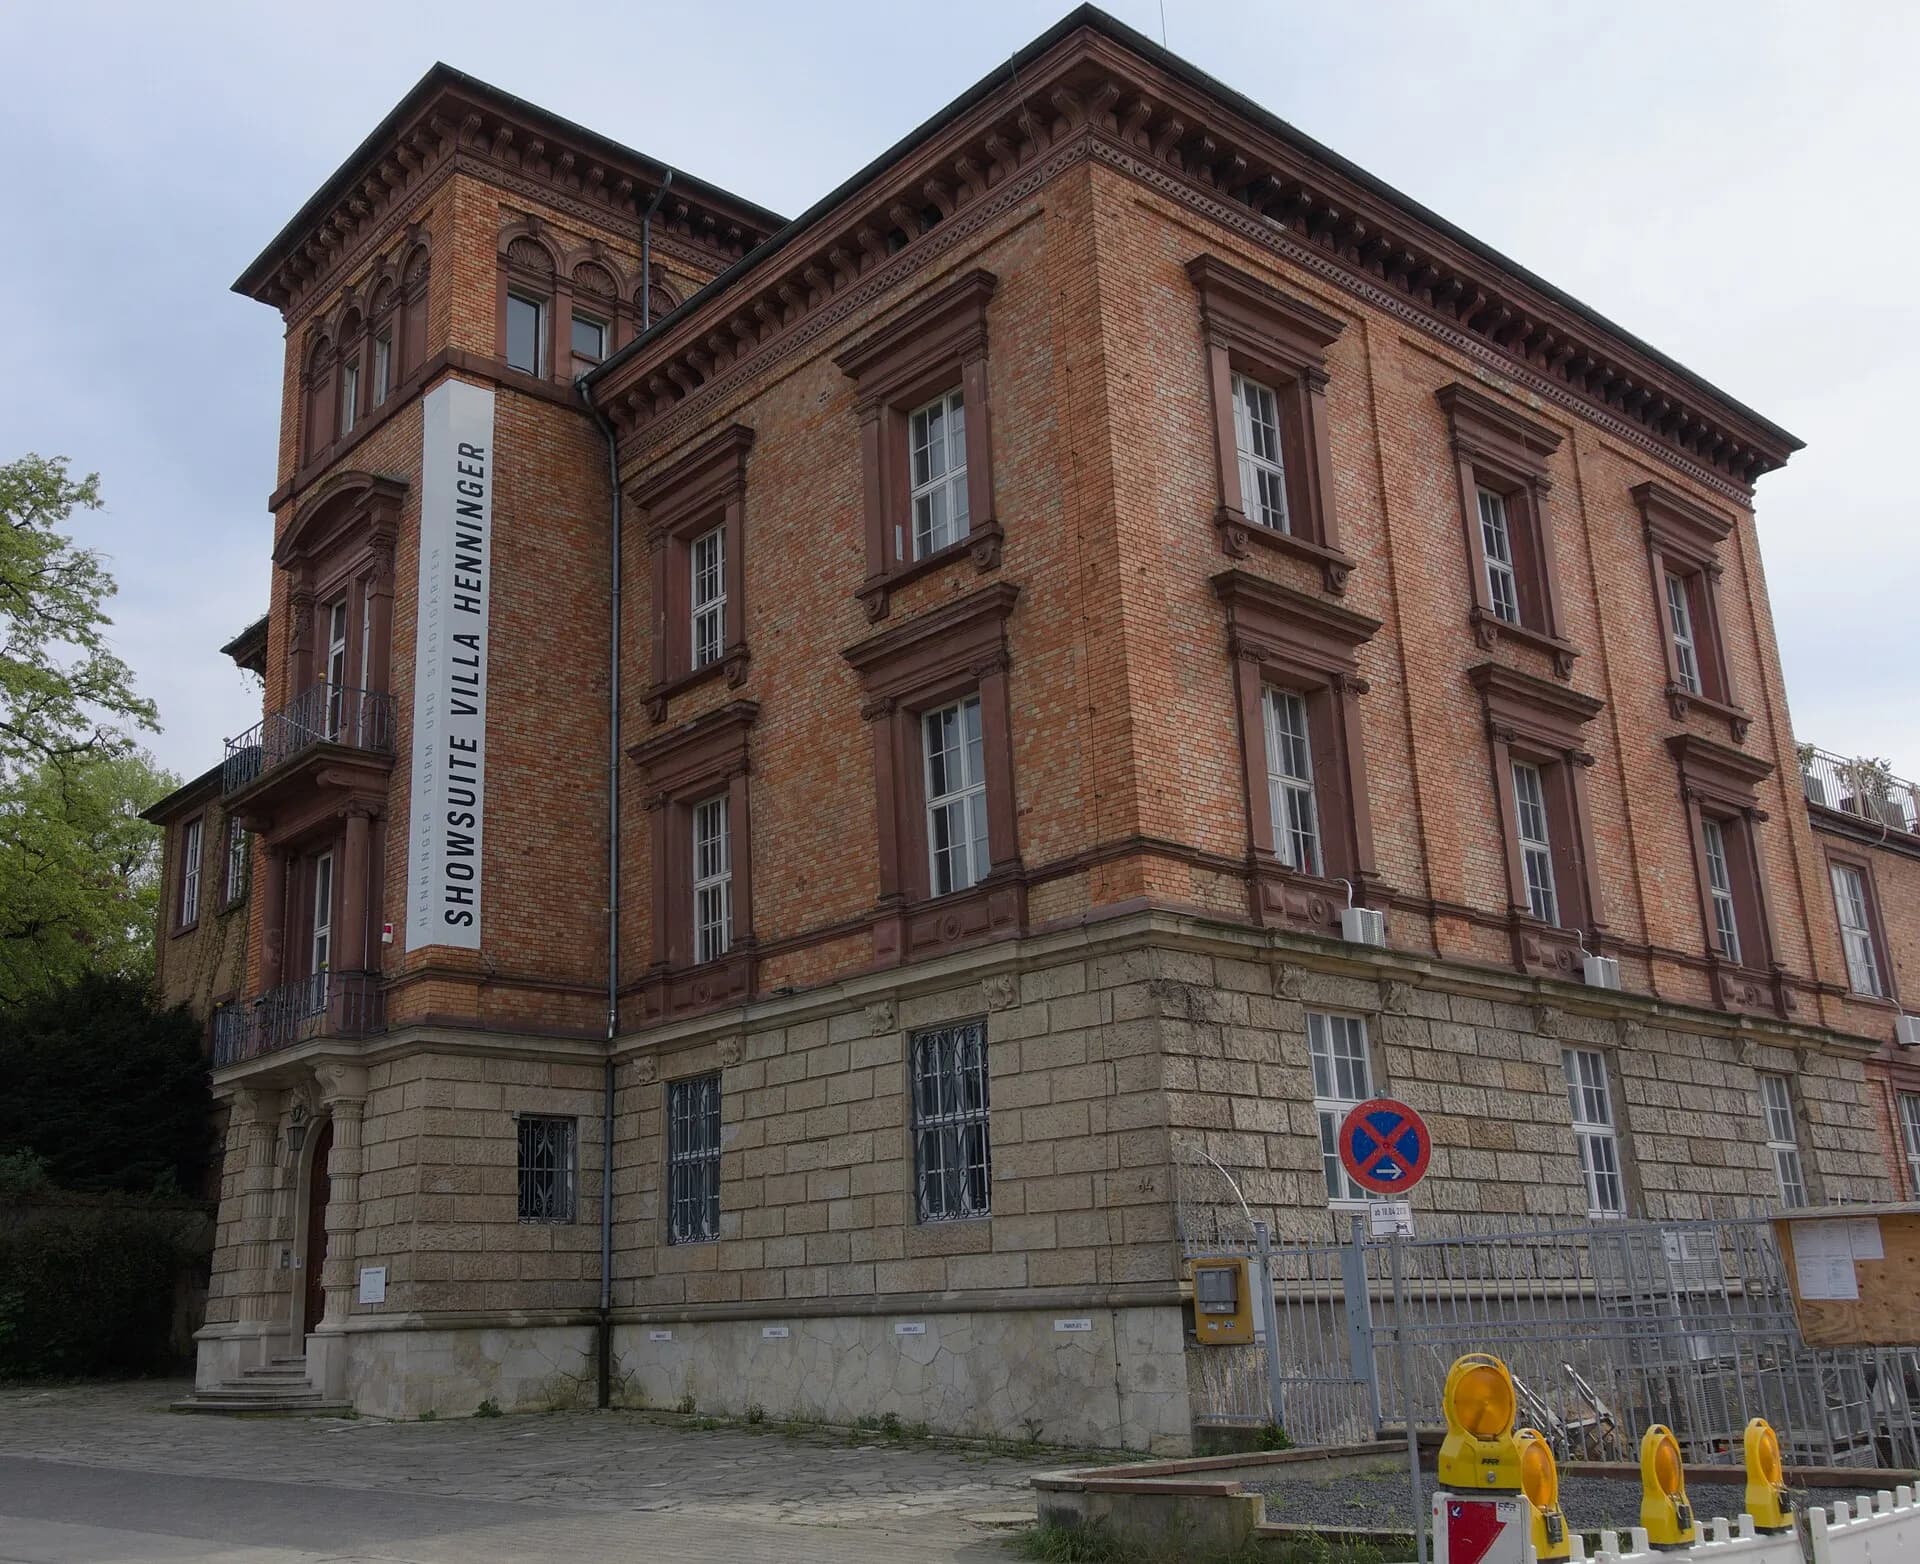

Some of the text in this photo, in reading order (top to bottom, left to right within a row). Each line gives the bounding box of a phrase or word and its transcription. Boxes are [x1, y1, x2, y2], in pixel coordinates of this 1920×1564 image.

[425, 692, 435, 730] UND
[445, 442, 484, 927] SHOWSUITE VILLA HENNINGER
[423, 744, 433, 795] TURM
[419, 812, 431, 927] HENNINGER
